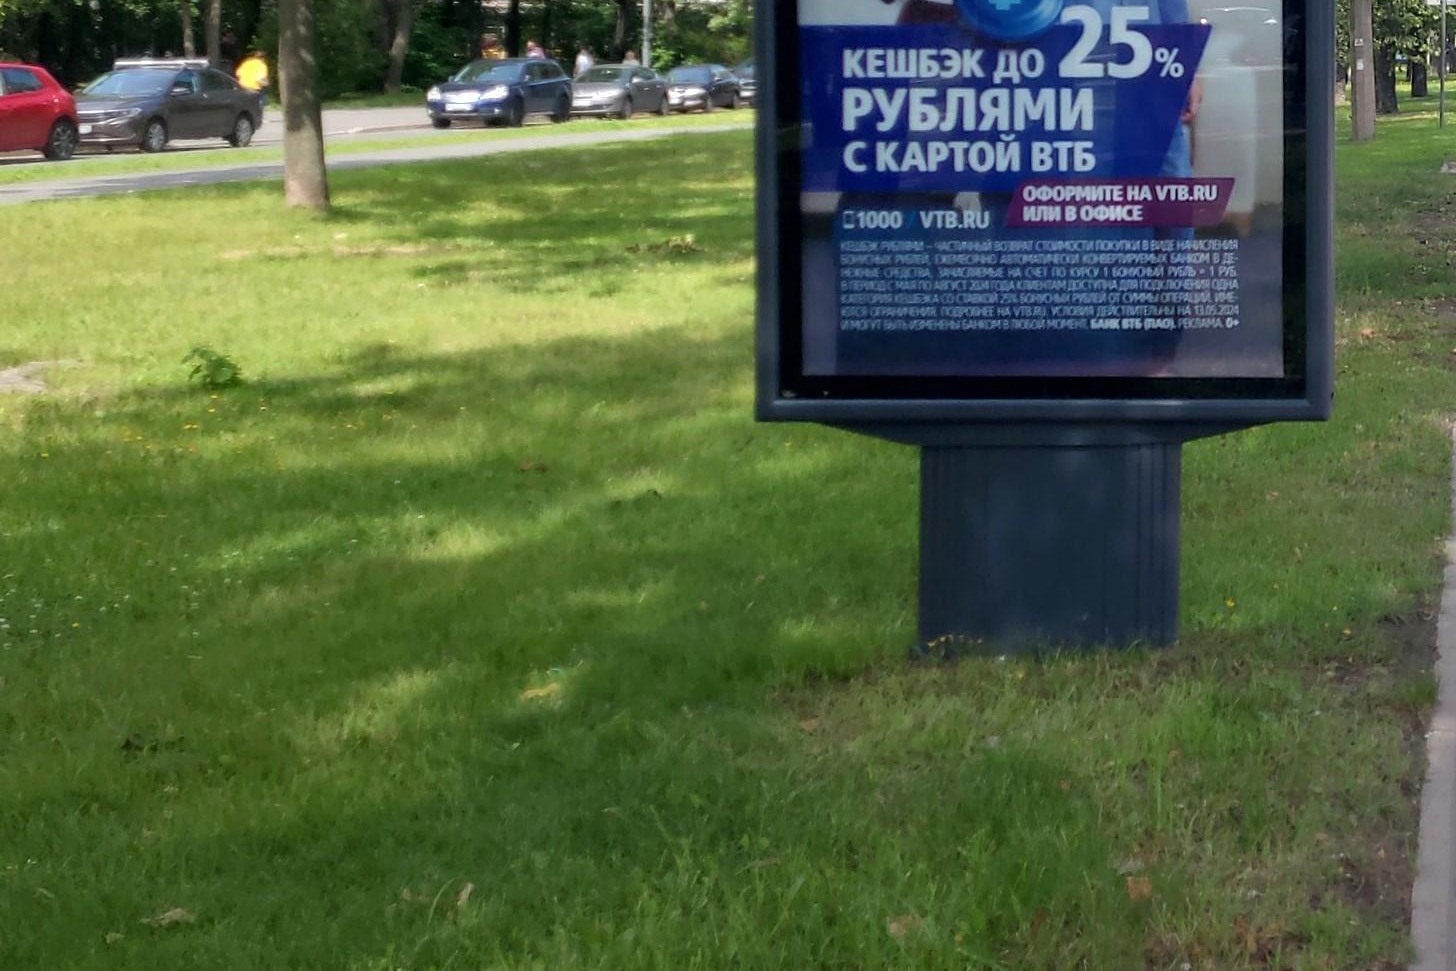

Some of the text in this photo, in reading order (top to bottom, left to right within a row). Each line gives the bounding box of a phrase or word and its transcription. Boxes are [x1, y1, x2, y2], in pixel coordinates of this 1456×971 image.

[842, 5, 1185, 84] КЕШБЭК ДО 25%
[842, 87, 1094, 131] РУБЛЯМИ
[843, 134, 1097, 172] С КАРТОЙ ВТБ
[1022, 184, 1218, 202] ОФОРМИТЕ НА VTB.RU
[857, 211, 990, 229] 1000 VTB.RU
[1022, 205, 1143, 222] ИЛИ В ОФИСЕ
